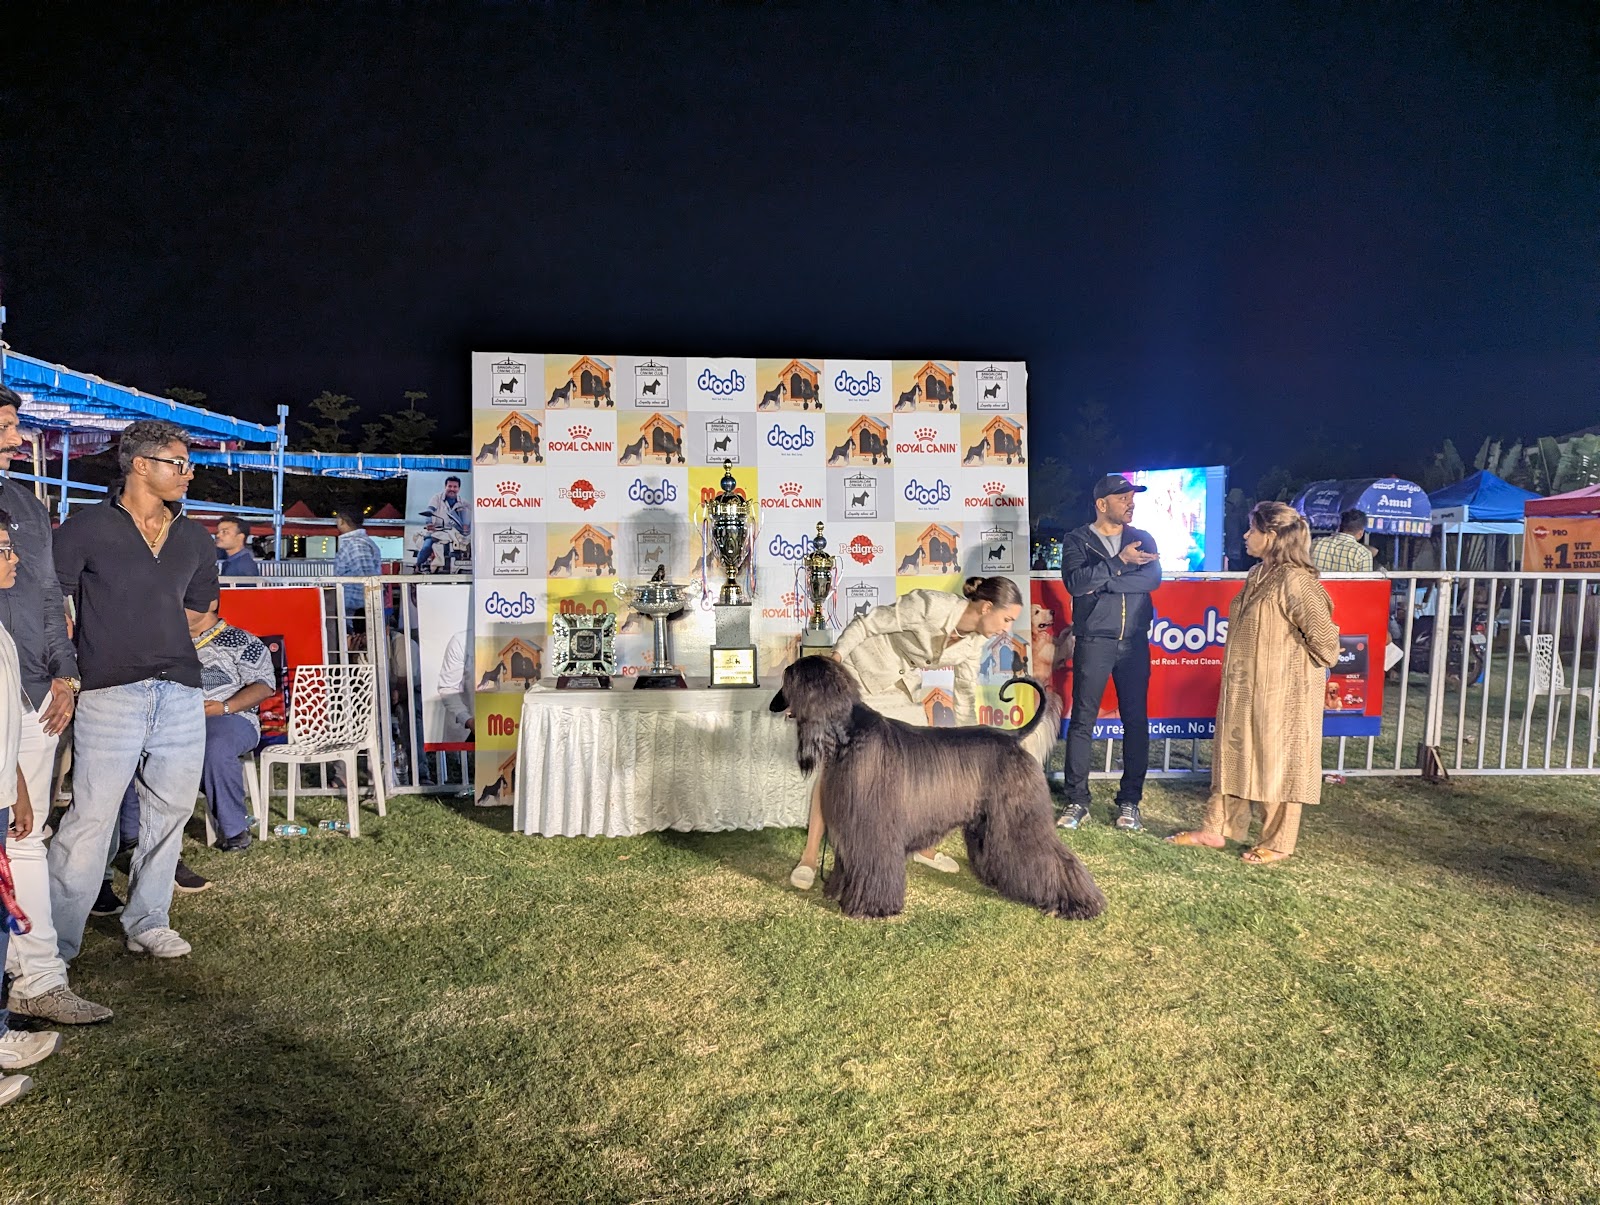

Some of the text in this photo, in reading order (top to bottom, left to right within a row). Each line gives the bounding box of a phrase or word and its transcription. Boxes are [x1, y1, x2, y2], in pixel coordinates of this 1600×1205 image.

[697, 368, 745, 395] drools
[834, 369, 881, 396] drools
[767, 423, 814, 451] drools
[548, 441, 612, 452] ROYAL CANIN
[896, 443, 956, 453] ROYAL CANIN
[559, 488, 606, 500] Pedigree
[628, 478, 677, 505] drools
[904, 478, 951, 505] drools
[476, 497, 541, 508] ROYAL CANIN
[760, 498, 822, 508] ROYAL CANIN
[964, 497, 1025, 507] ROYAL CANIN
[1377, 494, 1412, 509] Amul
[769, 534, 816, 561] drools
[839, 543, 884, 555] Pedigree
[1574, 542, 1592, 550] VET
[1543, 543, 1572, 569] #1
[485, 591, 535, 618] drools
[762, 608, 791, 618] ROYAL
[1161, 658, 1180, 666] Real.
[1181, 658, 1199, 666] Feed
[1200, 658, 1223, 666] Clean.
[488, 713, 519, 736] Me-
[1148, 722, 1184, 734] icken.
[1188, 722, 1205, 734] No
